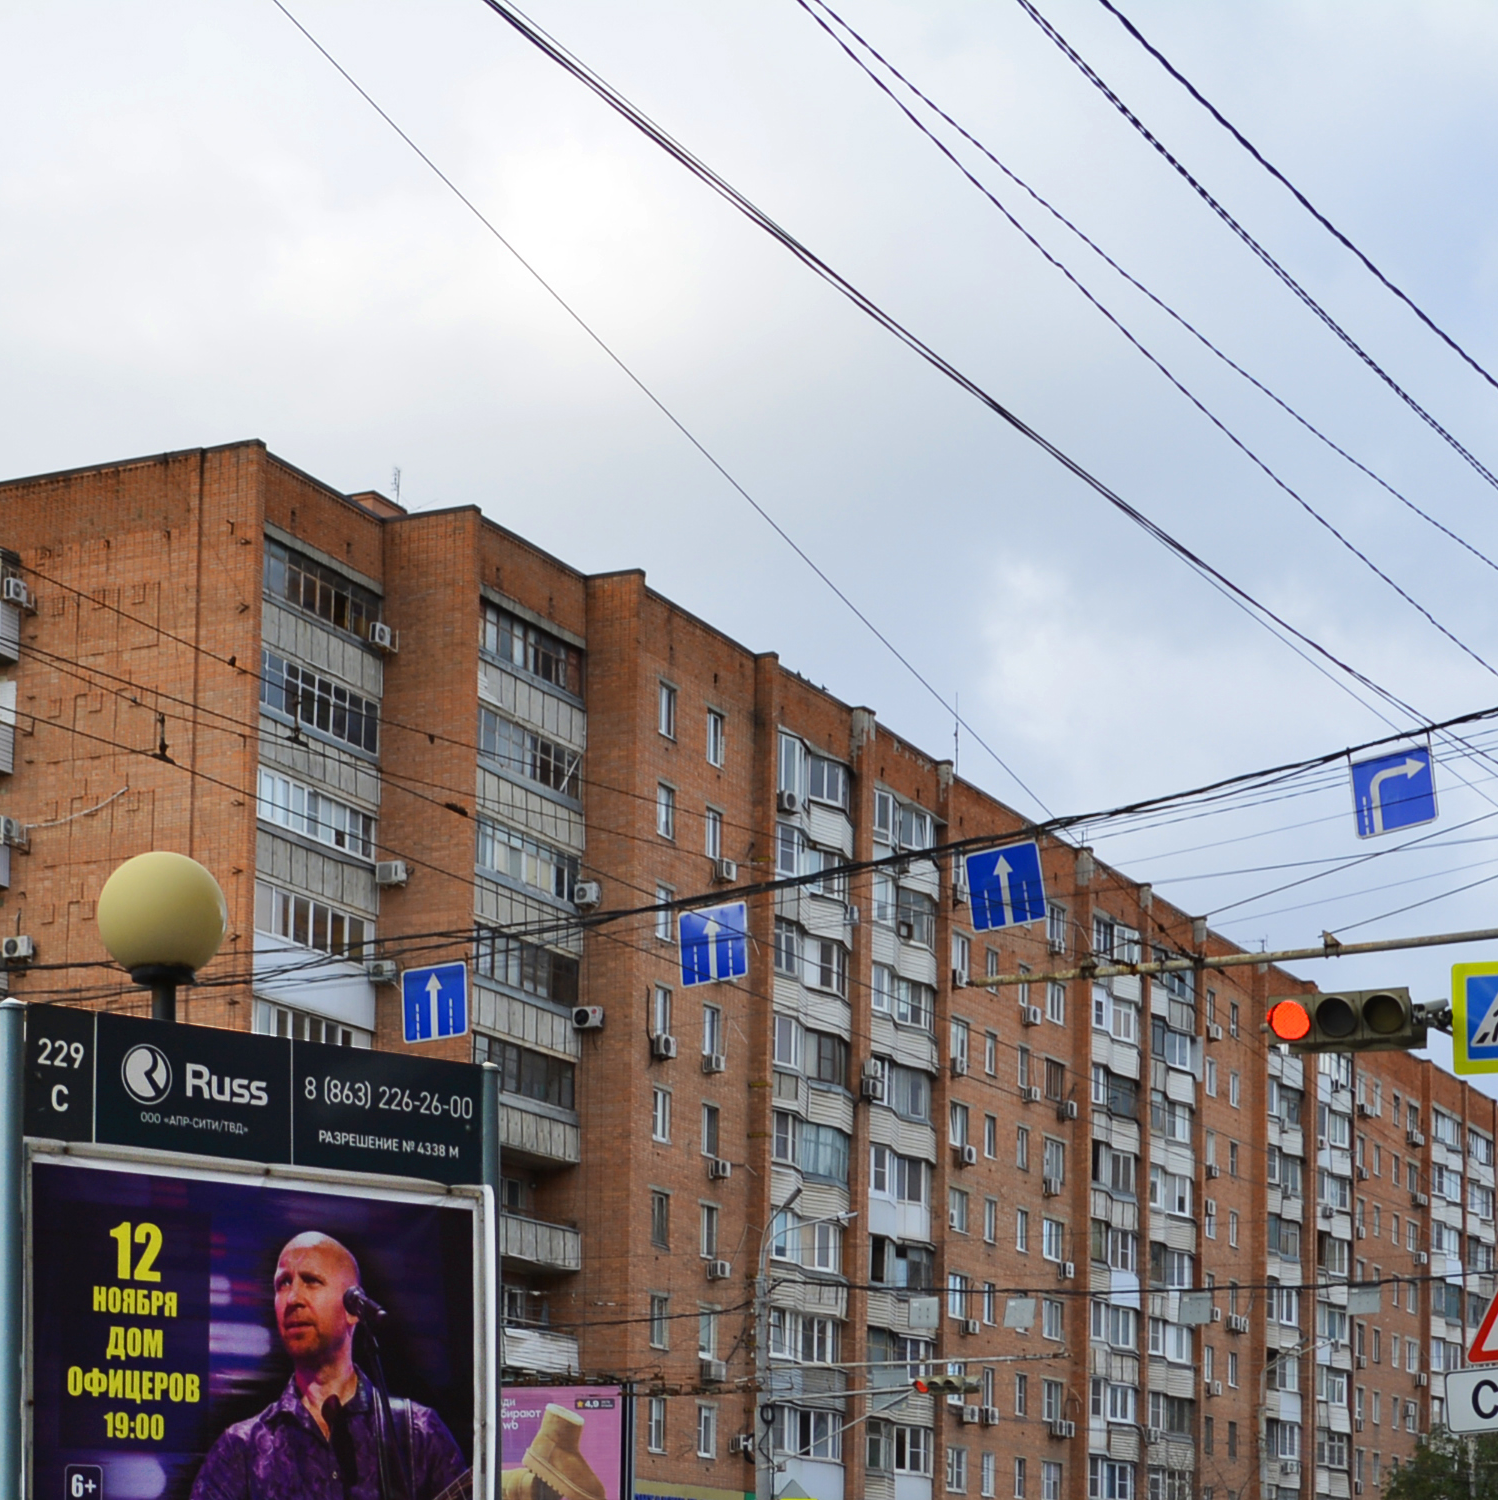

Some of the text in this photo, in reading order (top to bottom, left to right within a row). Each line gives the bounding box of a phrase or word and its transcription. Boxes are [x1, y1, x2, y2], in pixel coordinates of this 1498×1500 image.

[36, 1036, 85, 1069] 229
[185, 1063, 268, 1107] Russ
[304, 1076, 473, 1120] 8 (863) 226-26-00
[140, 1111, 249, 1136] ООО «АПР-СИТИ/ТВД»
[318, 1129, 459, 1159] РАЗРЕШЕНИЕ № 4338 М
[109, 1221, 163, 1282] 12
[93, 1285, 178, 1317] НОЯБРЯ
[106, 1326, 163, 1360] ДОМ
[67, 1365, 200, 1404] ОФИЦЕРОВ
[501, 1398, 516, 1407] ди
[501, 1408, 542, 1419] бирают
[584, 1400, 599, 1408] 4,9
[103, 1411, 165, 1440] 19:00
[503, 1420, 519, 1430] wb
[70, 1473, 97, 1498] 6+
